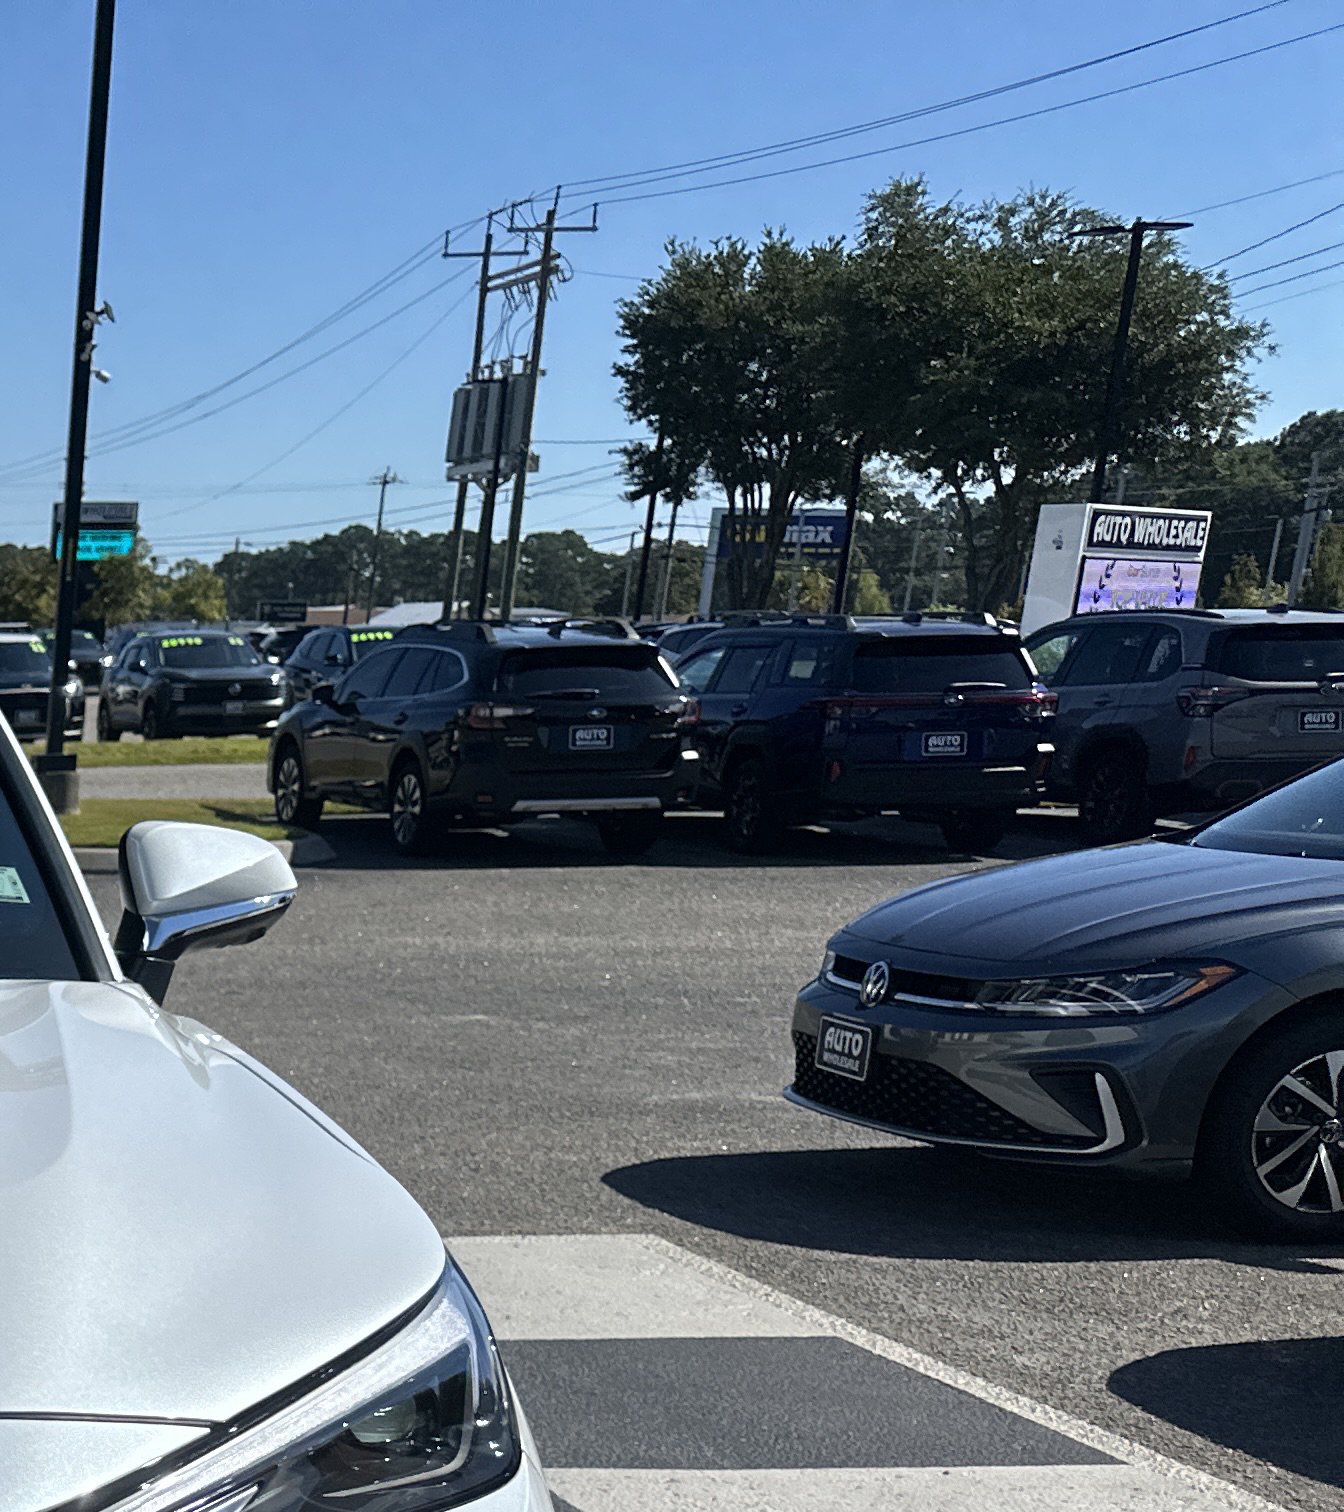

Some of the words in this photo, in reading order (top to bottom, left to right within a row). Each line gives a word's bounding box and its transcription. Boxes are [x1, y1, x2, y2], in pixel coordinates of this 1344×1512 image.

[1093, 515, 1131, 544] AUTO
[1134, 517, 1206, 547] WHOLESALE
[1304, 712, 1336, 724] AUTO
[575, 729, 608, 740] AUTO
[928, 735, 961, 746] AUTO
[824, 1026, 864, 1057] AUTO
[823, 1051, 859, 1071] WHOLESALE
